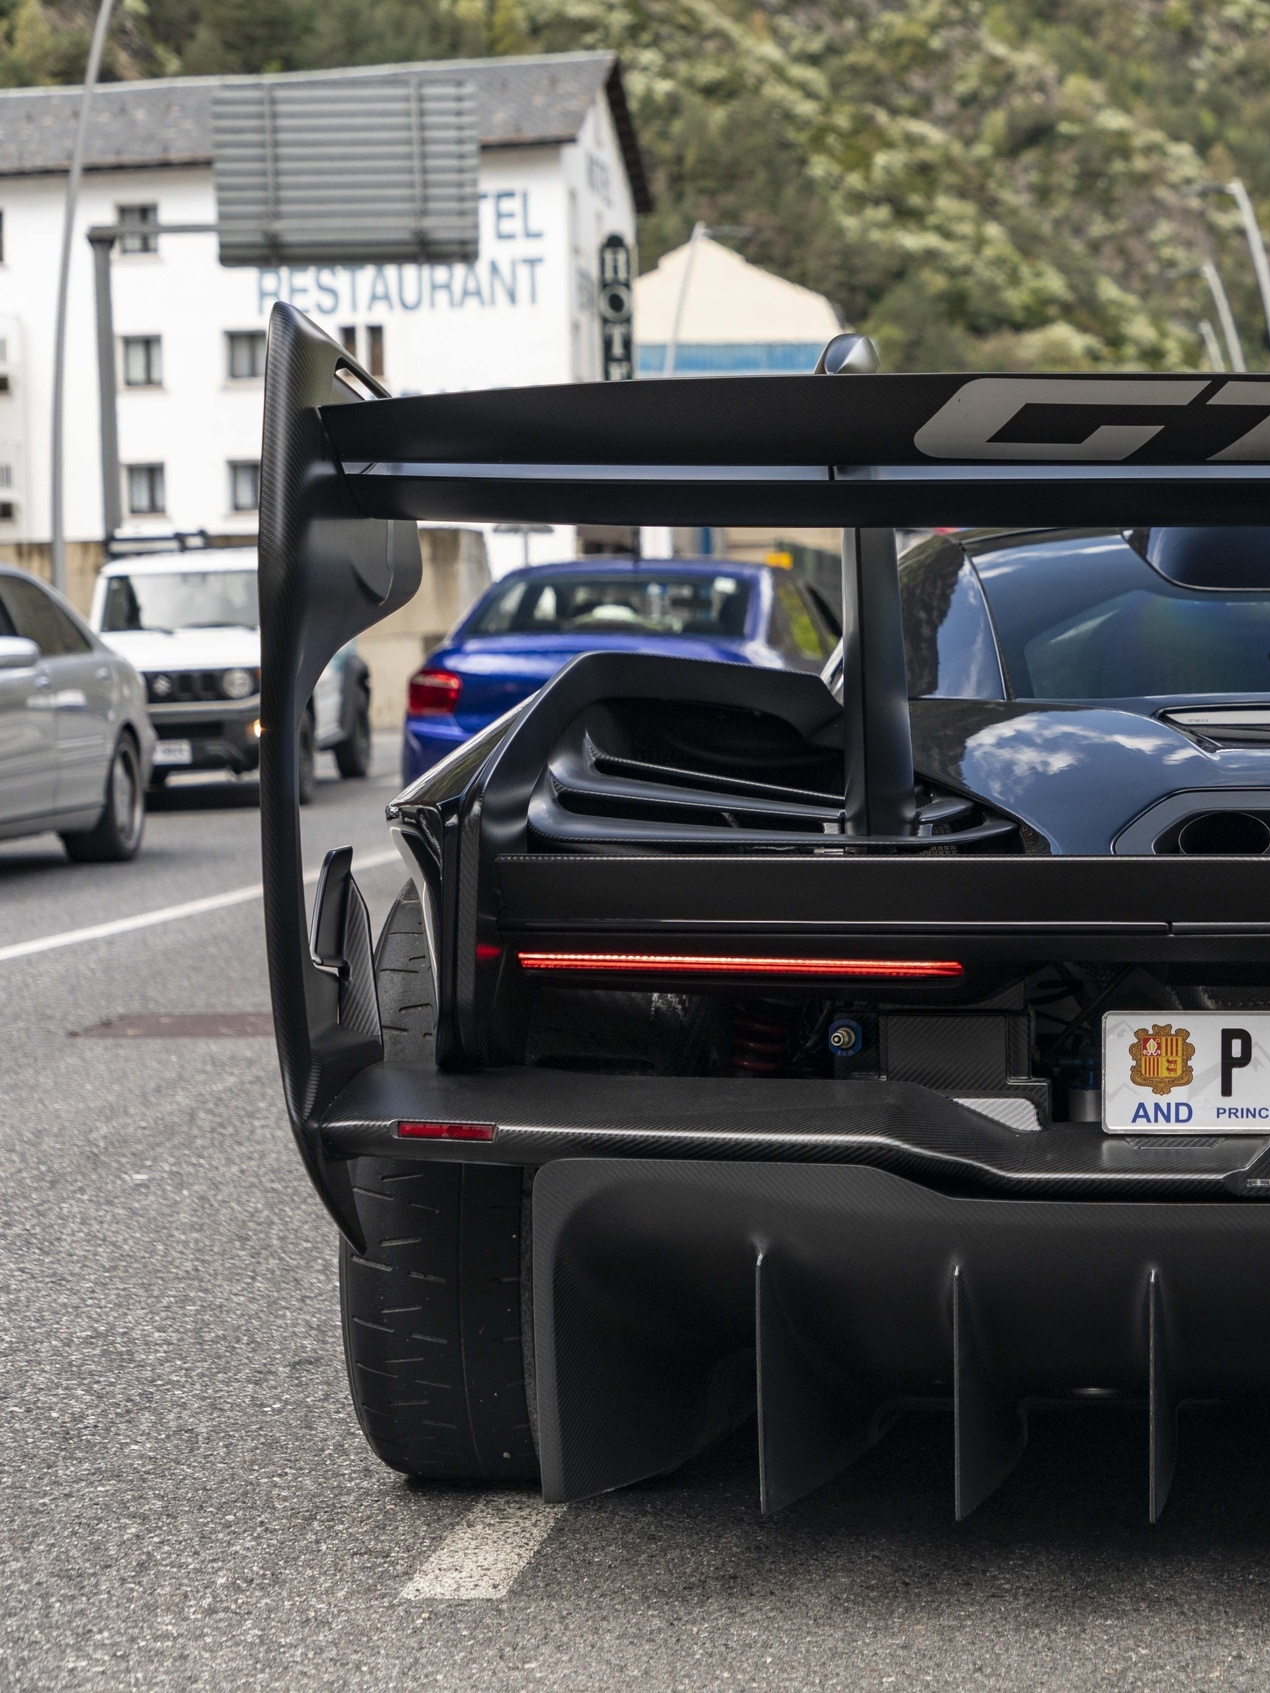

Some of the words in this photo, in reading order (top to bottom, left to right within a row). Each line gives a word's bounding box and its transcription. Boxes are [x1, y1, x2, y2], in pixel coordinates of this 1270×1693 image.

[478, 190, 544, 240] EL
[256, 258, 544, 316] RESTAURANT
[1220, 1028, 1253, 1097] P
[1131, 1102, 1193, 1124] AND
